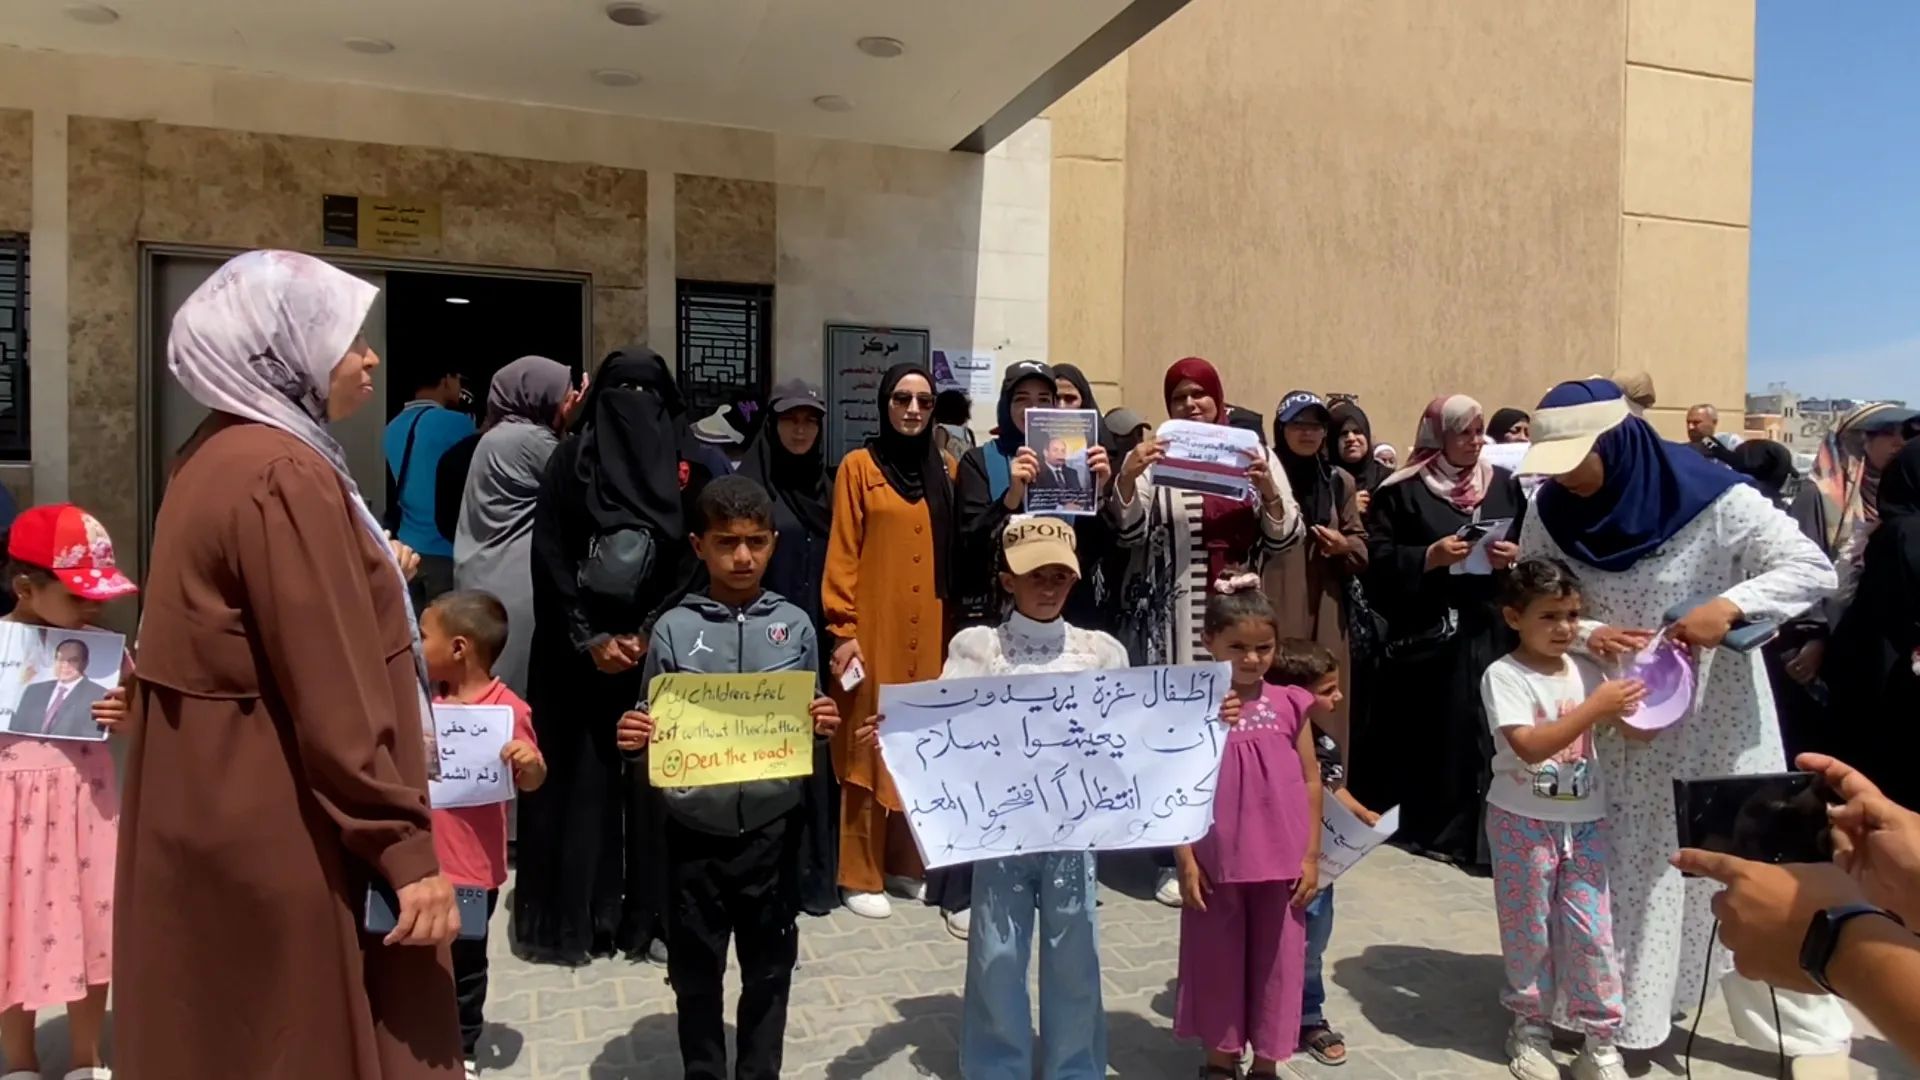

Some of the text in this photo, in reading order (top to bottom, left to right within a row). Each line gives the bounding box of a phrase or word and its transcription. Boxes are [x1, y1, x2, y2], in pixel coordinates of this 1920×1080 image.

[860, 336, 899, 356] مركز
[650, 676, 685, 720] My
[902, 668, 1215, 717] أطفال غزة يريدون
[470, 724, 488, 736] من
[915, 715, 1218, 770] أن يعيشوا بسلام
[441, 747, 456, 760] مع
[662, 748, 720, 783] Open
[725, 746, 747, 765] the
[975, 774, 1049, 830] افتحوا
